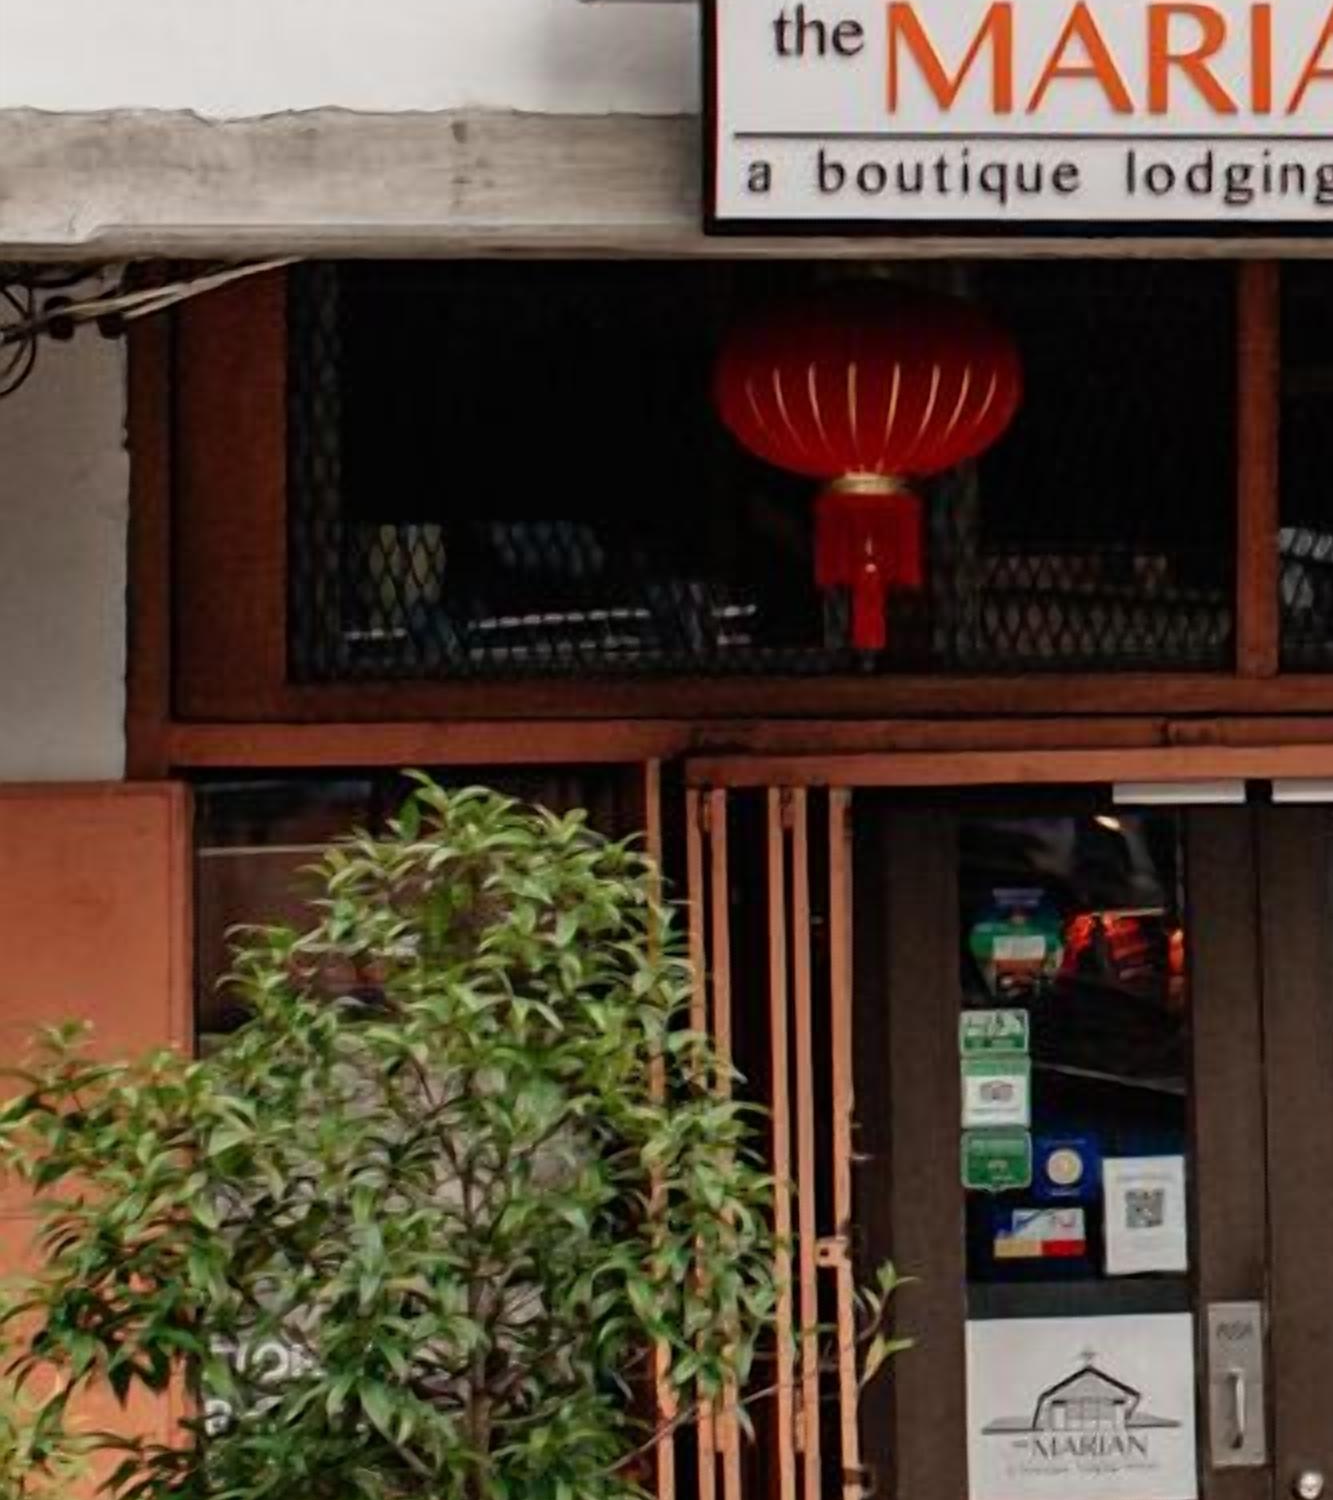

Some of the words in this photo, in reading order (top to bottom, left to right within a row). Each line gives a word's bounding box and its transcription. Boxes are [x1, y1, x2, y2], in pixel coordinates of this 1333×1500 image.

[773, 2, 865, 57] the
[747, 160, 773, 193] a
[817, 146, 1081, 205] boutique
[1032, 1435, 1150, 1459] MARIAN
